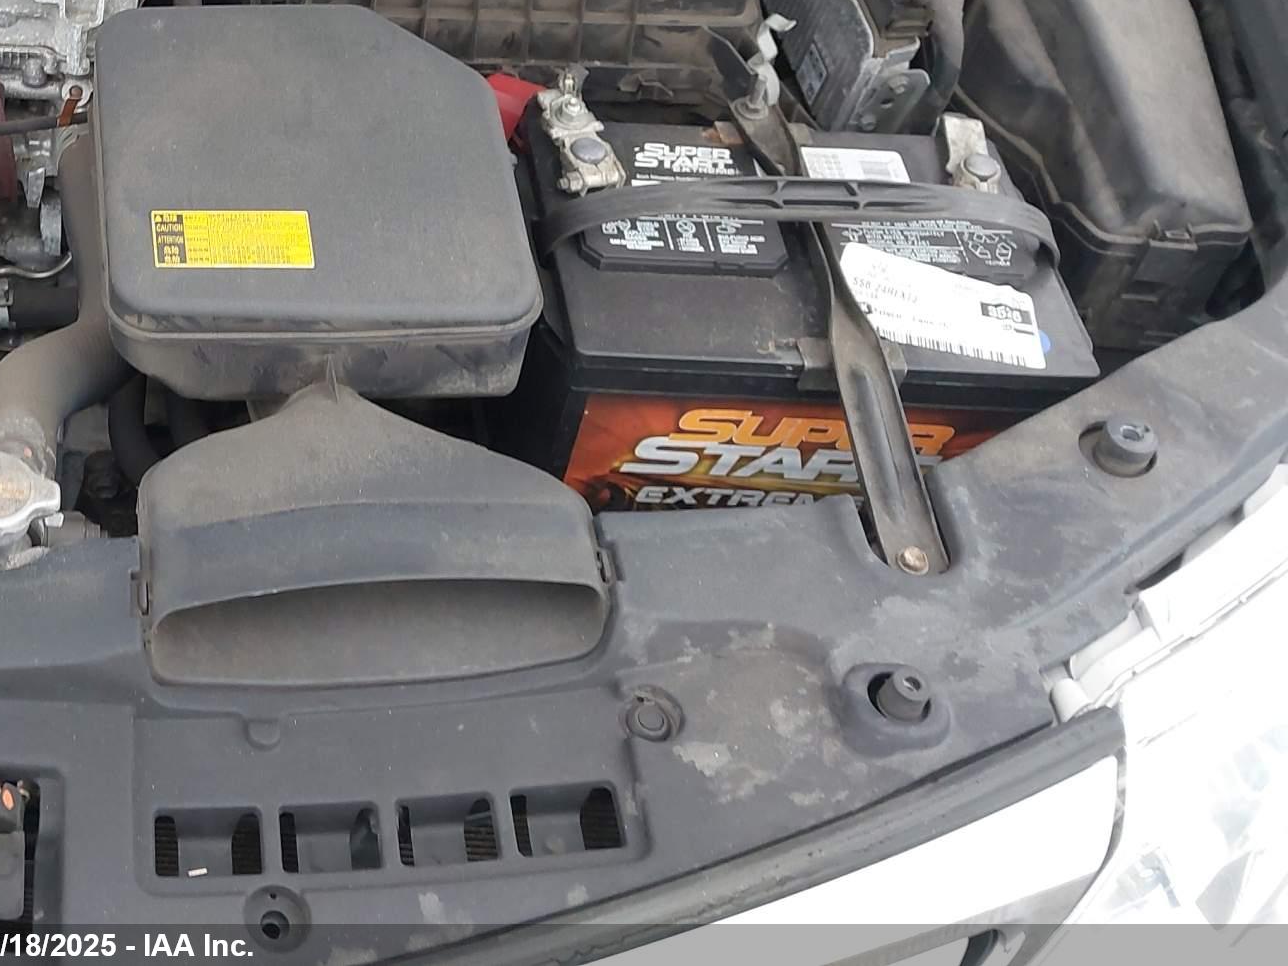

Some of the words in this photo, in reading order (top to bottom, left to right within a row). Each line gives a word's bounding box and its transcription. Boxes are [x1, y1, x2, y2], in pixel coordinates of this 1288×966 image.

[643, 142, 731, 160] SUPER
[634, 152, 733, 169] START
[156, 223, 183, 232] CAUTION
[157, 234, 184, 244] ATTENTION
[668, 408, 955, 455] SUPR
[619, 436, 943, 483] STAR
